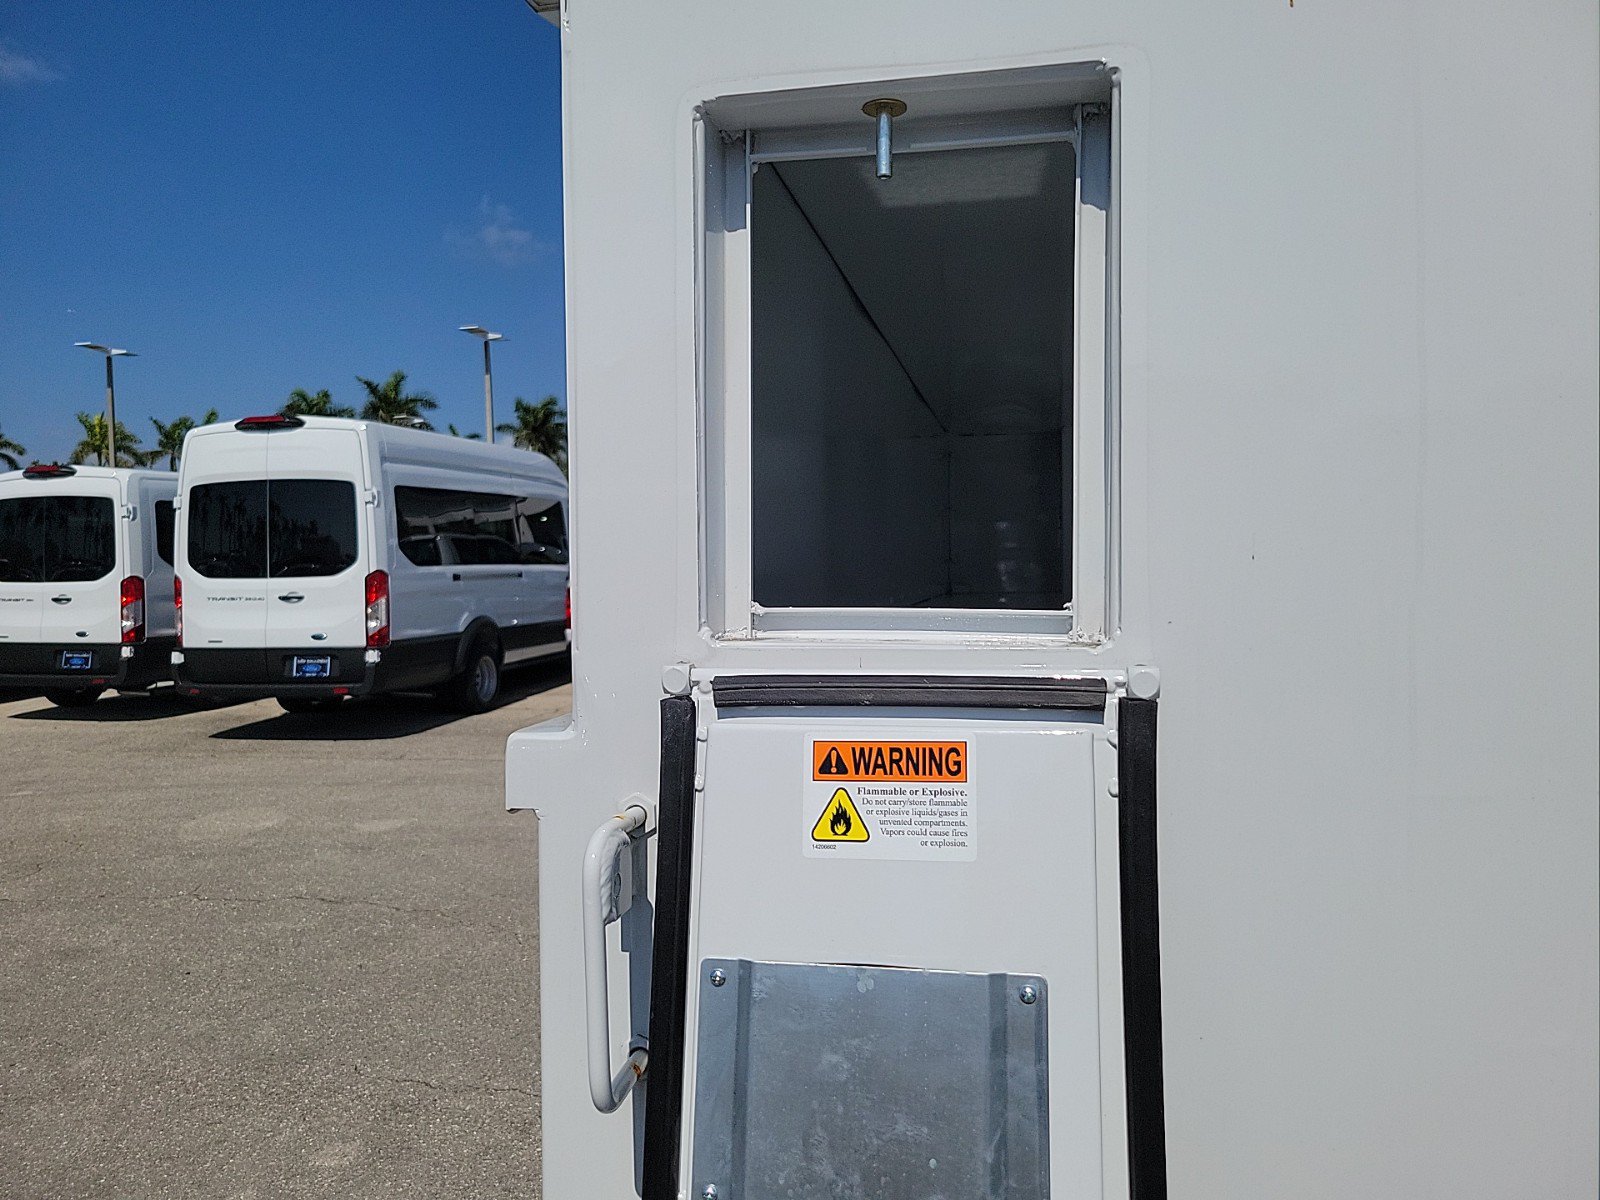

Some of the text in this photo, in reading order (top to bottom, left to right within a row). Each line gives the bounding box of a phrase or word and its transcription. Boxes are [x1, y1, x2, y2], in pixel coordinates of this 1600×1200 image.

[852, 747, 962, 776] WARNING
[857, 787, 907, 795] Flammable
[922, 788, 967, 797] Explosive.
[888, 798, 926, 807] carry/store
[876, 809, 909, 817] explosive
[912, 809, 958, 818] liquids/gases
[914, 819, 968, 827] compartments.
[881, 828, 904, 837] Vapors
[930, 840, 968, 848] explosion.
